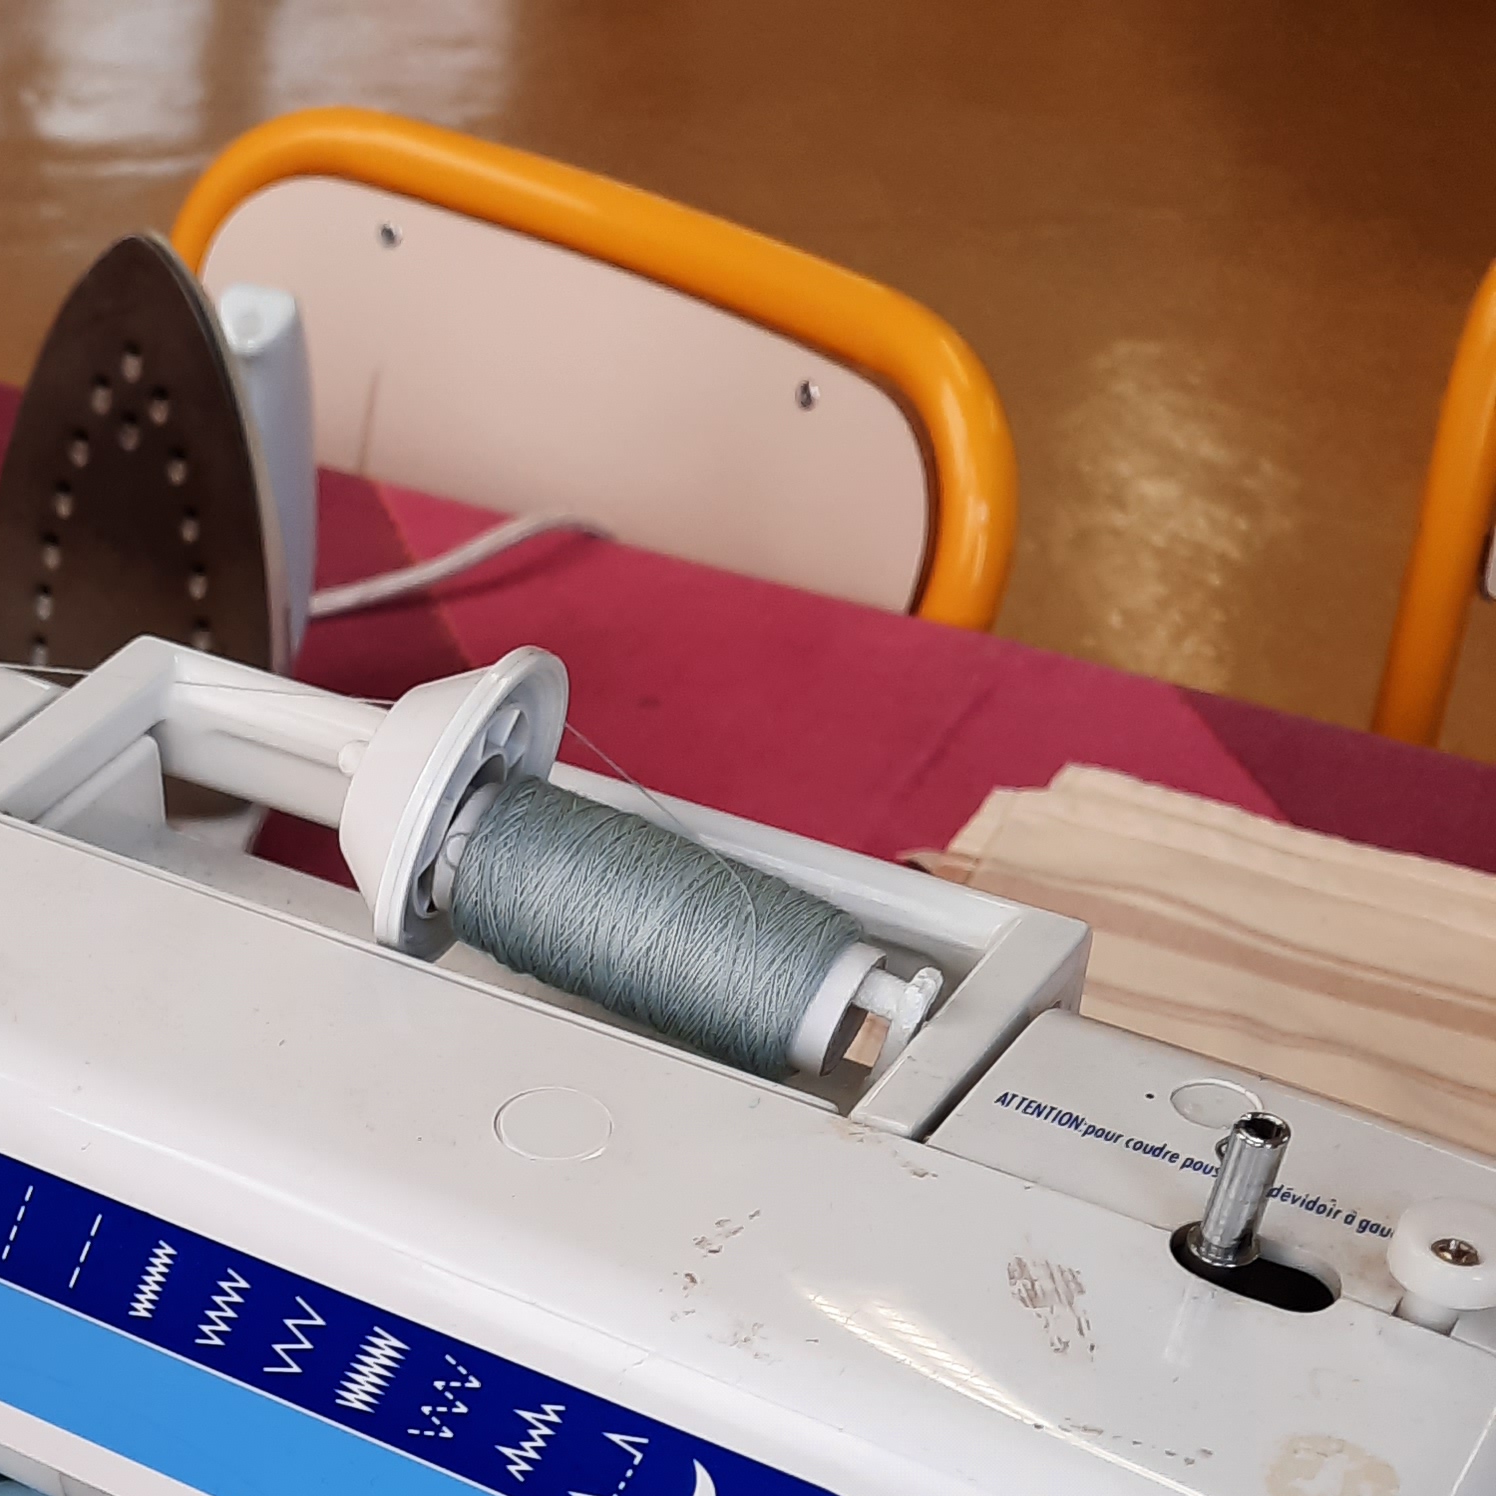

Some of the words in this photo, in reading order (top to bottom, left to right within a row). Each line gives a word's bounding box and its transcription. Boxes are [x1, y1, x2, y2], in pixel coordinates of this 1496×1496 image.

[1125, 1137, 1180, 1164] coudre
[1180, 1156, 1221, 1178] pous
[1356, 1219, 1394, 1239] gau
